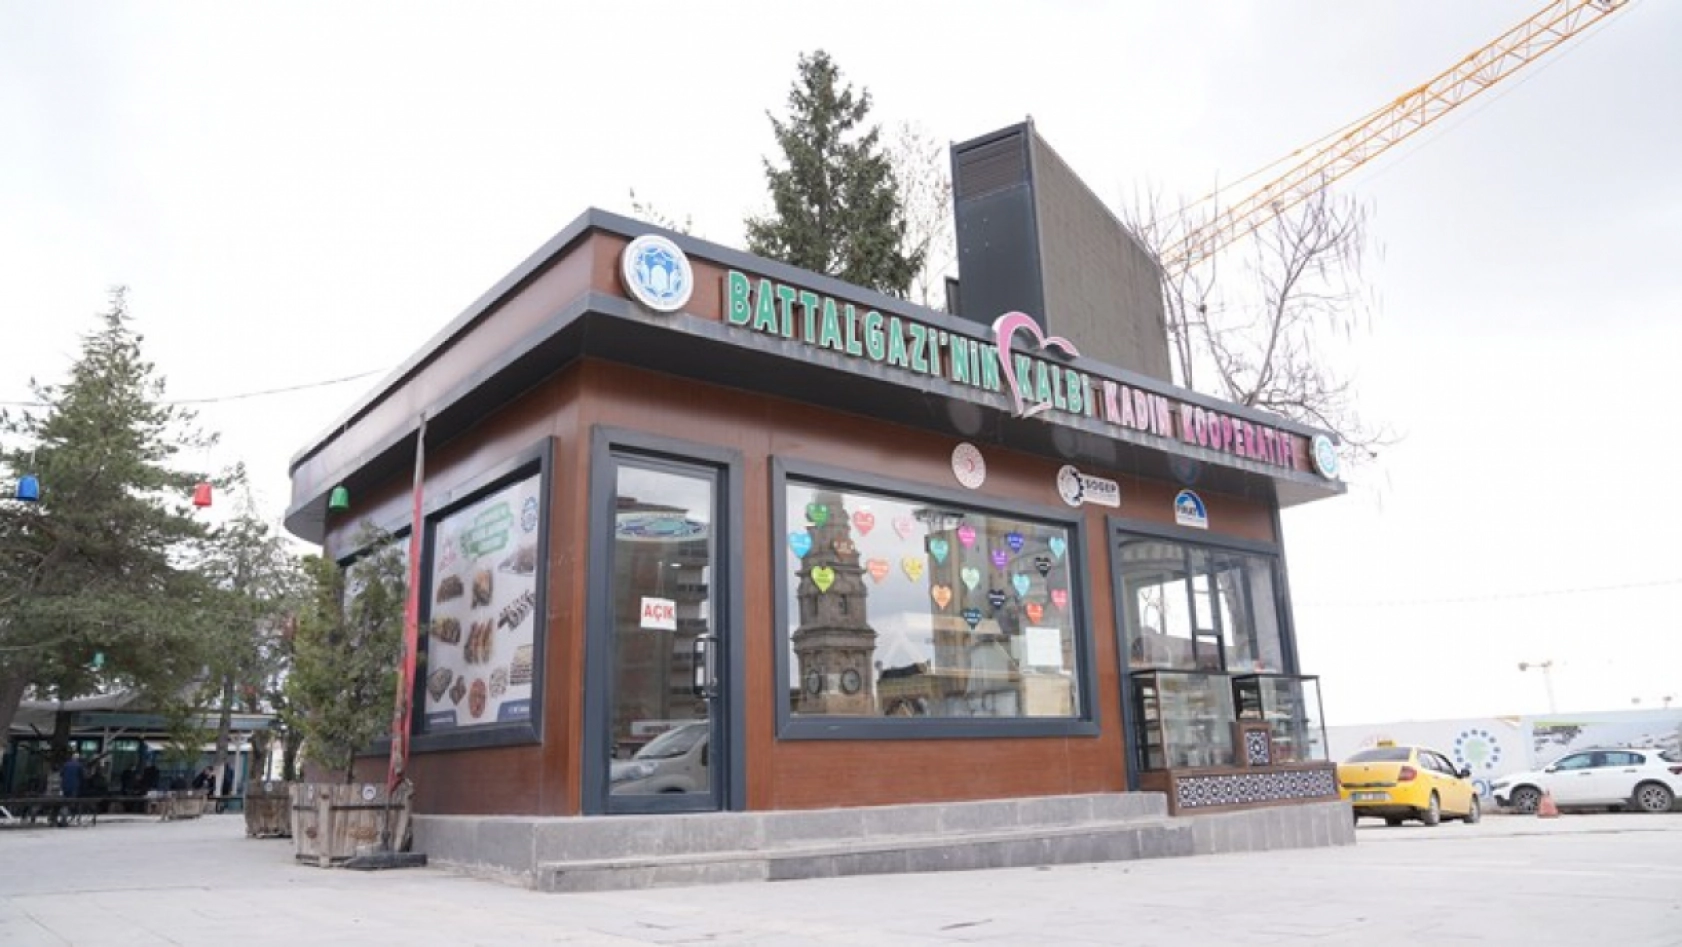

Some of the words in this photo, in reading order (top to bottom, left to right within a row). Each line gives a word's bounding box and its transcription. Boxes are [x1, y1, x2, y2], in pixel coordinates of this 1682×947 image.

[728, 269, 1001, 393] BATTALGAZİ'NİN
[1102, 380, 1172, 438] KADIN
[644, 603, 675, 622] AÇIK
